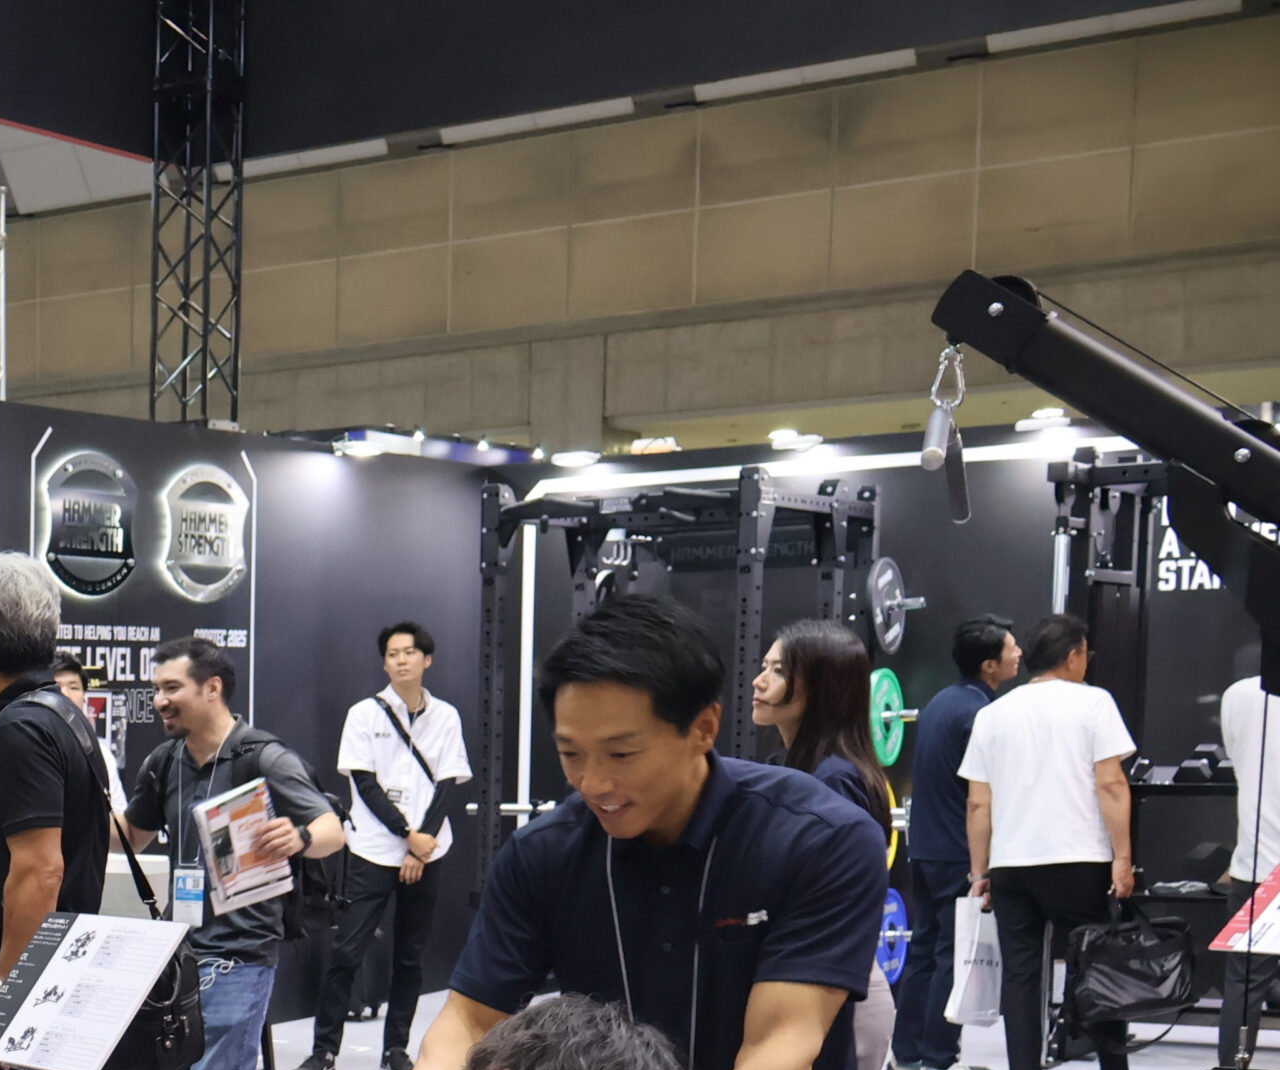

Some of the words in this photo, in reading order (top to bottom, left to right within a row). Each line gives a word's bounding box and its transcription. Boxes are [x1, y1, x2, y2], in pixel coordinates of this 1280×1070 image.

[62, 498, 122, 528] HAMMER
[84, 624, 113, 641] HELPING
[113, 625, 127, 641] YOU
[128, 626, 150, 642] REACH
[227, 629, 248, 648] 2025
[176, 878, 185, 889] A
